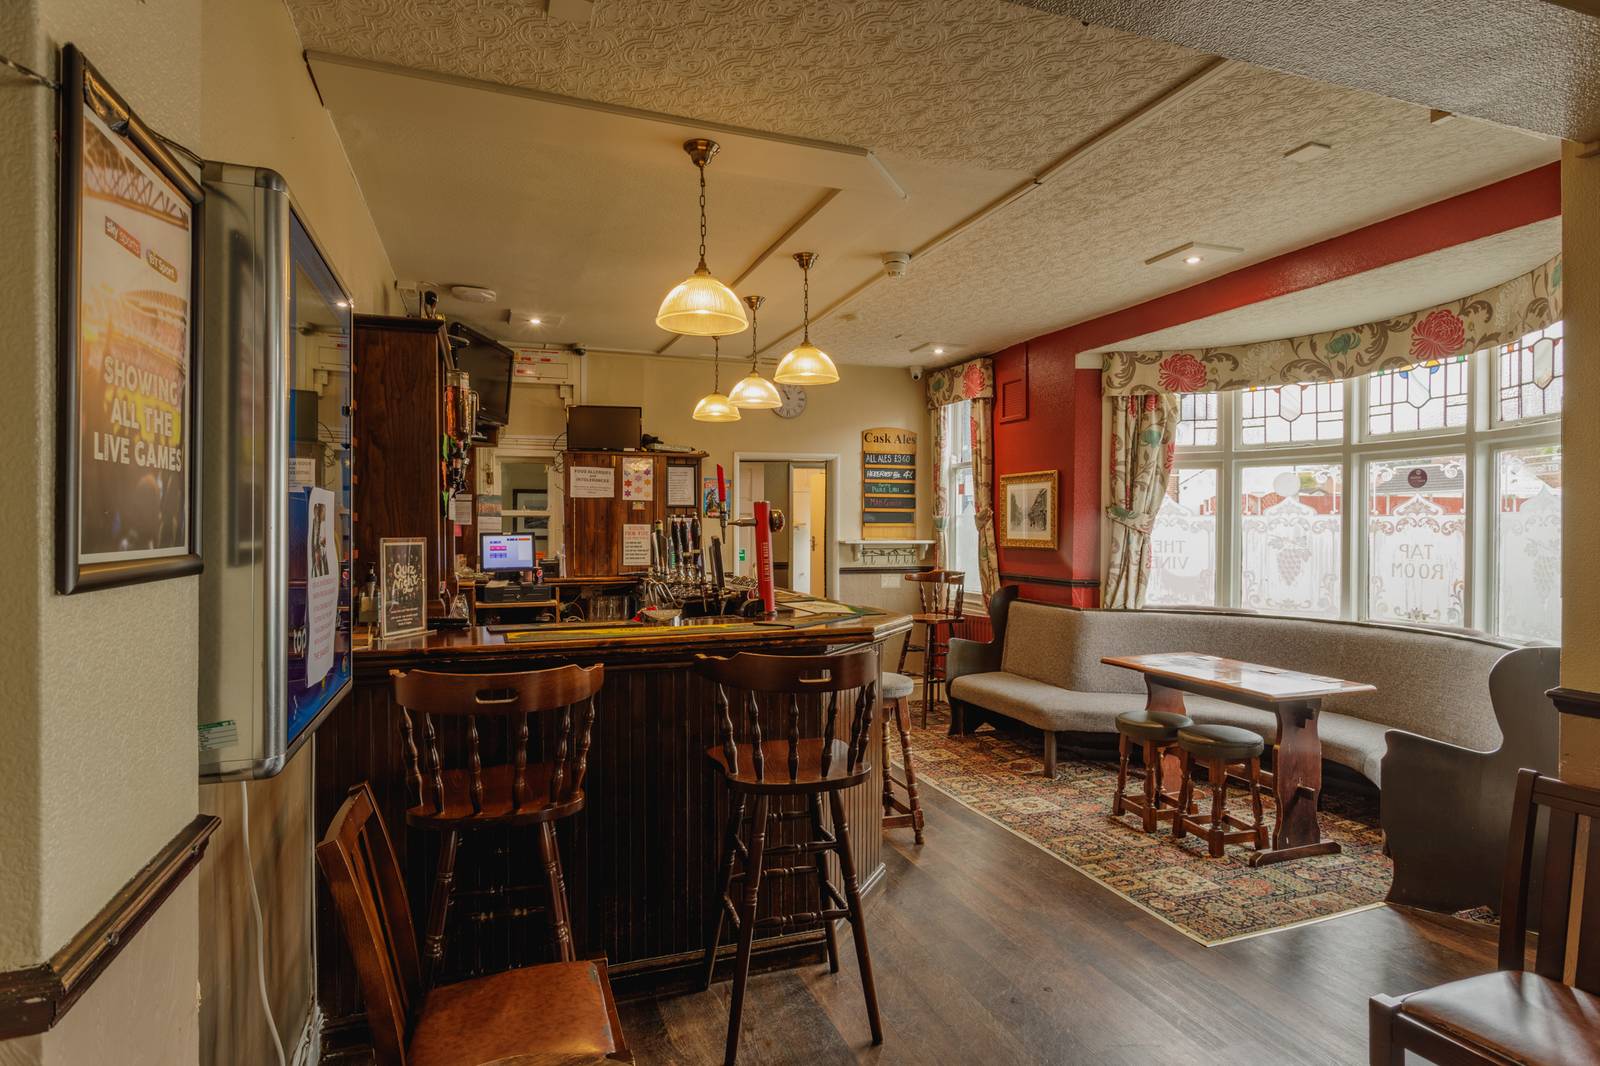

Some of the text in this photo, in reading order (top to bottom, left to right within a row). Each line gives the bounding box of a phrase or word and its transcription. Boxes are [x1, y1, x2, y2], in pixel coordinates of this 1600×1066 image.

[106, 220, 118, 241] sky
[104, 356, 178, 405] SHOWING
[111, 398, 172, 437] ALL THE
[864, 432, 917, 445] Cask Ales
[94, 432, 182, 472] LIVE GAMES
[866, 454, 877, 463] ALL
[878, 454, 892, 463] ALES
[393, 562, 416, 578] Quiz
[392, 574, 419, 590] Night
